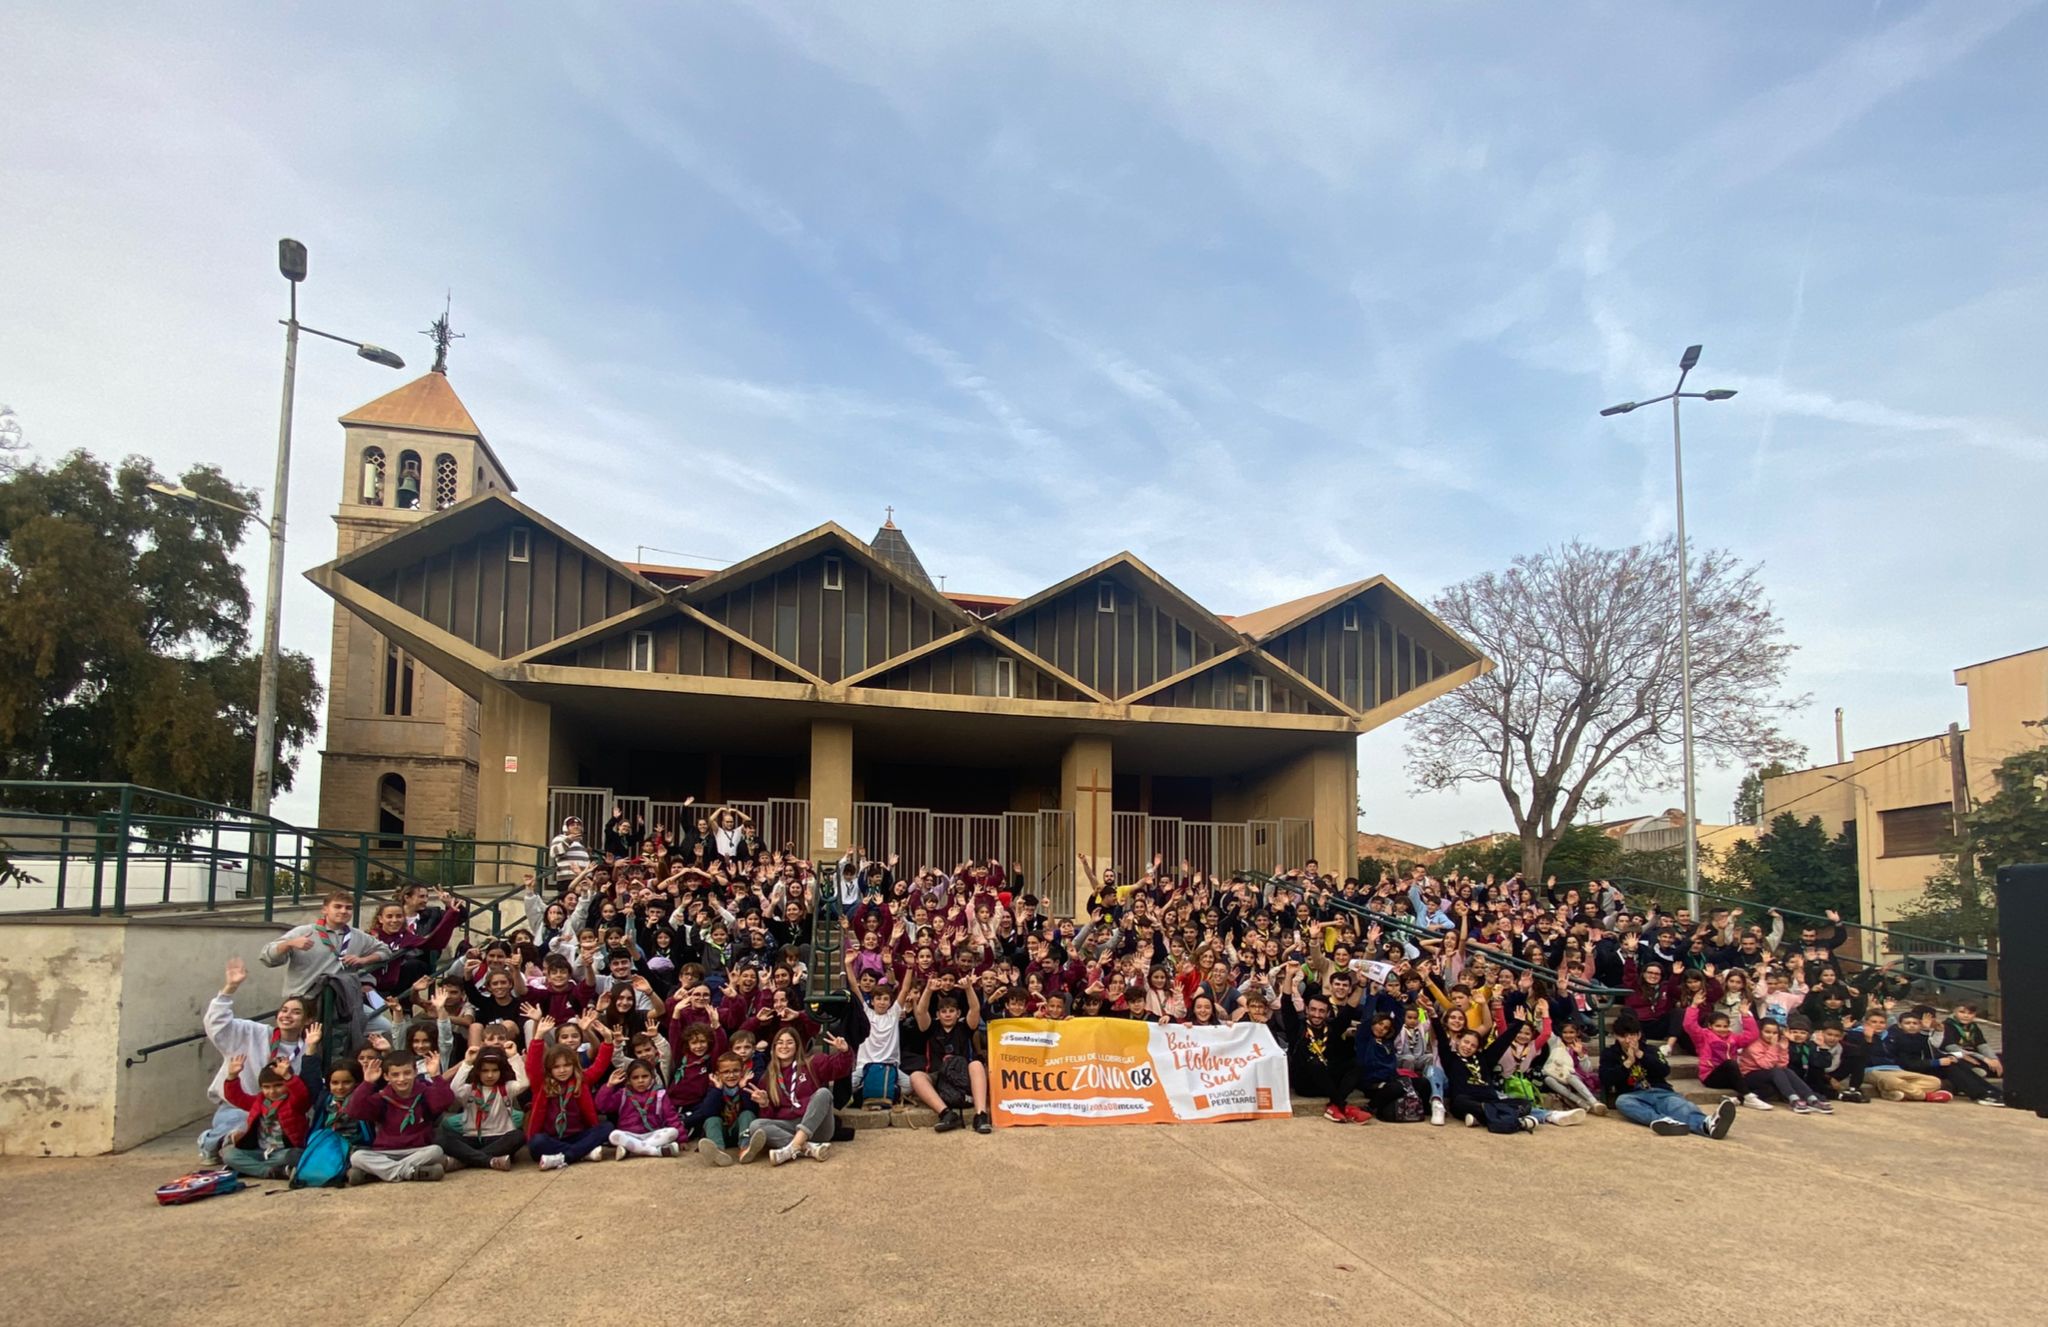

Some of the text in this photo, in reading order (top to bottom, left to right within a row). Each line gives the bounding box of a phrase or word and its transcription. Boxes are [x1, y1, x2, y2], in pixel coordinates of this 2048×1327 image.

[1165, 1032, 1199, 1051] Baix
[1000, 1052, 1135, 1066] TERRITORI SANT FELIU DE LLOBREGAT
[1172, 1043, 1265, 1071] Llobregat
[1001, 1064, 1153, 1092] MCECC ZONA 08
[1200, 1067, 1240, 1088] Sud
[1208, 1088, 1246, 1099] FUNDACIÓ
[1211, 1098, 1231, 1107] PERE
